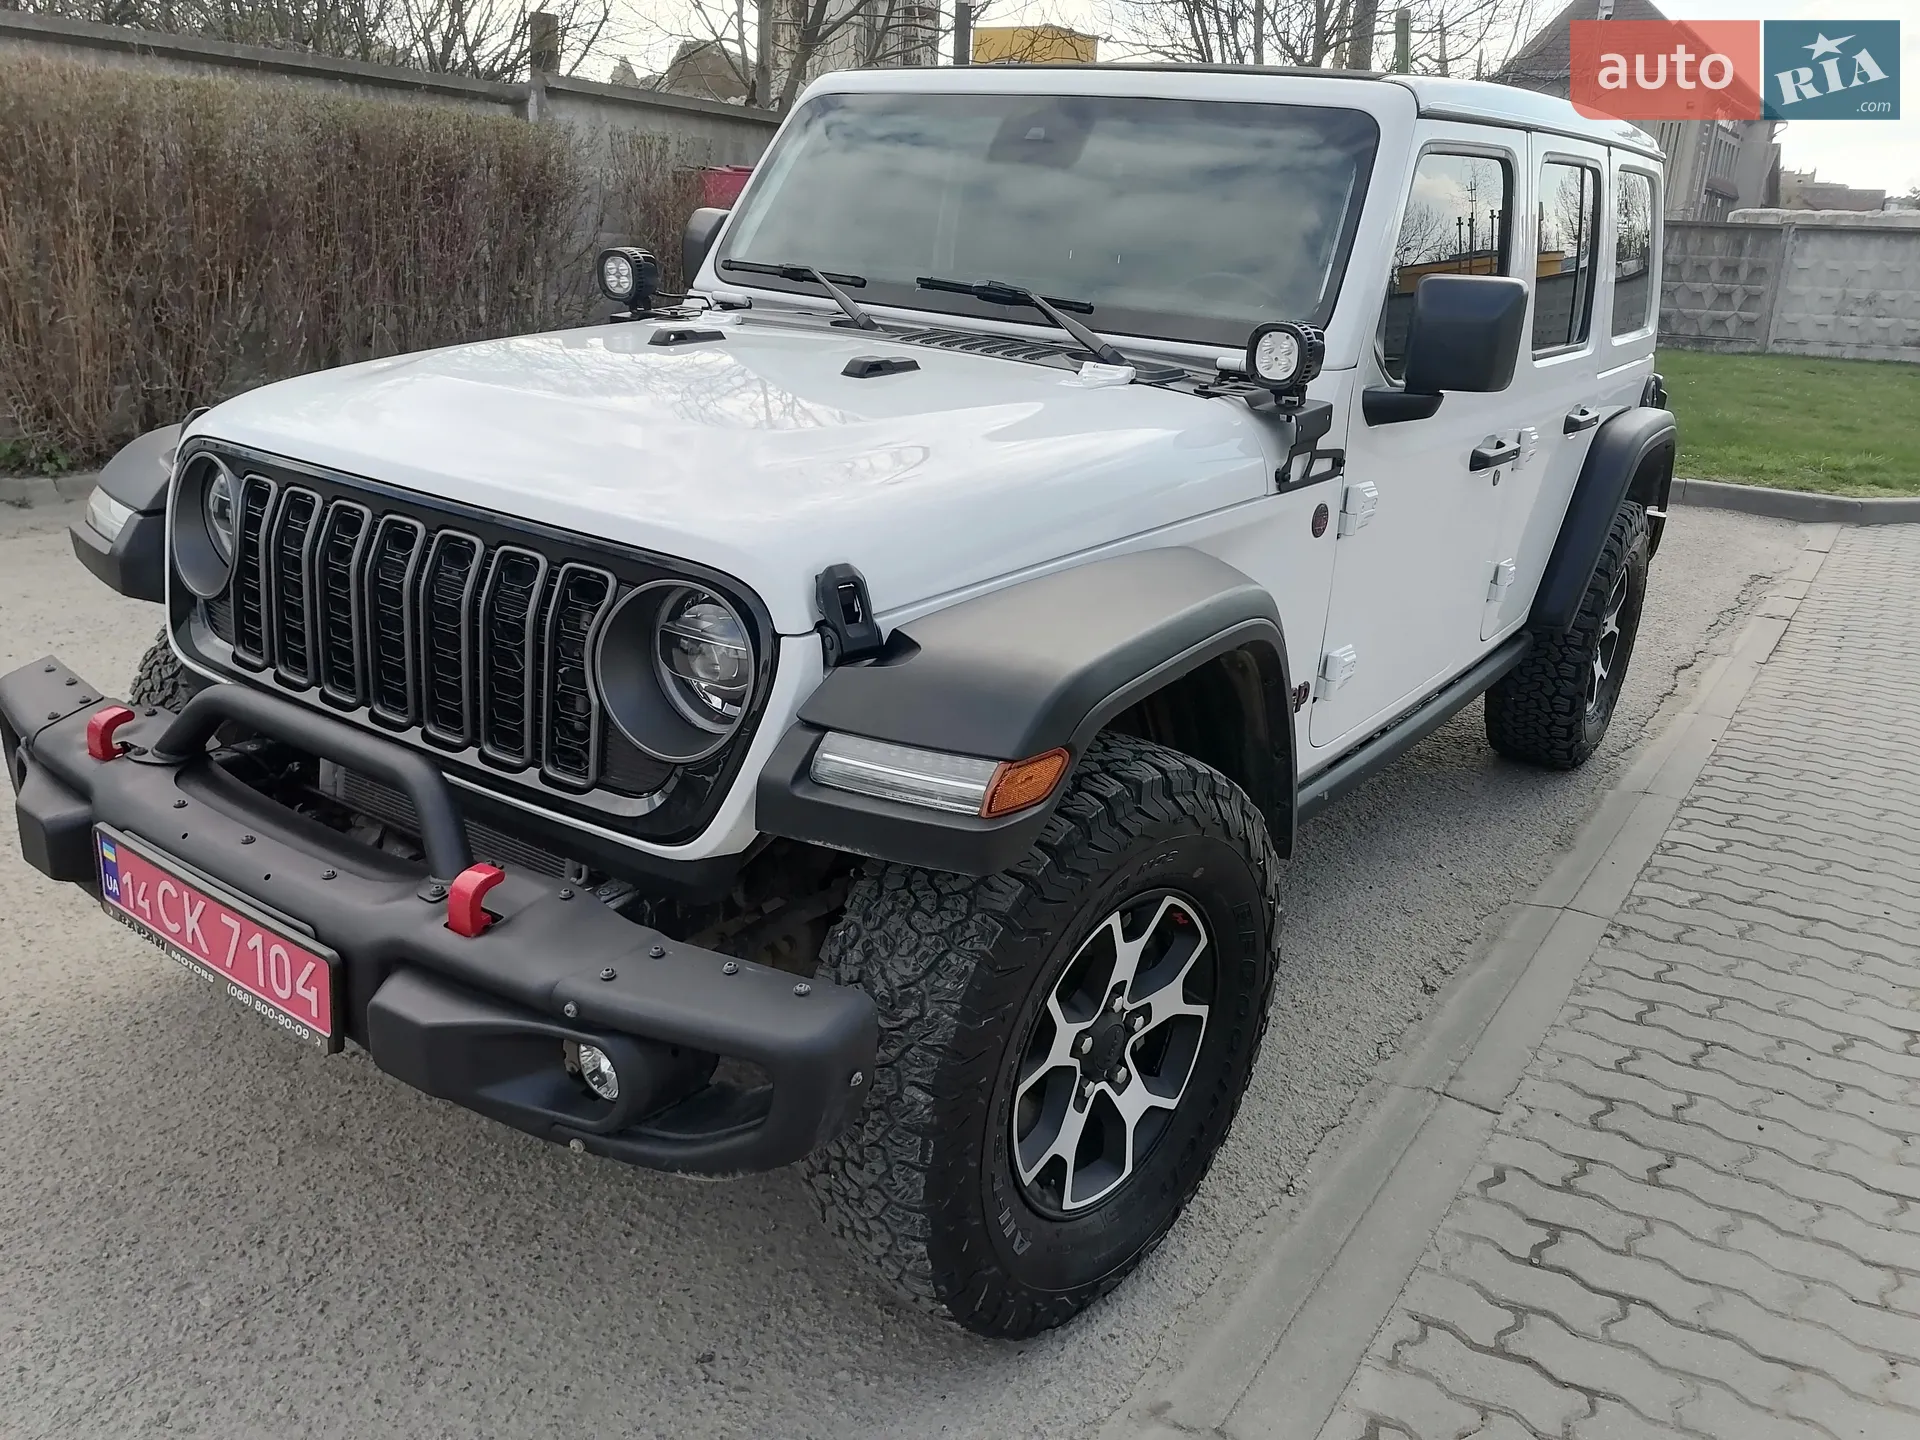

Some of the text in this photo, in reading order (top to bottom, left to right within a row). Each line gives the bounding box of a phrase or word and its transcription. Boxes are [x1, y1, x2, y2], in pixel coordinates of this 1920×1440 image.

[106, 873, 120, 896] UA
[171, 950, 214, 983] MOTORS
[227, 982, 253, 1007] (068)
[254, 1000, 310, 1040] 800-90-09
[220, 912, 319, 1018] 7104
